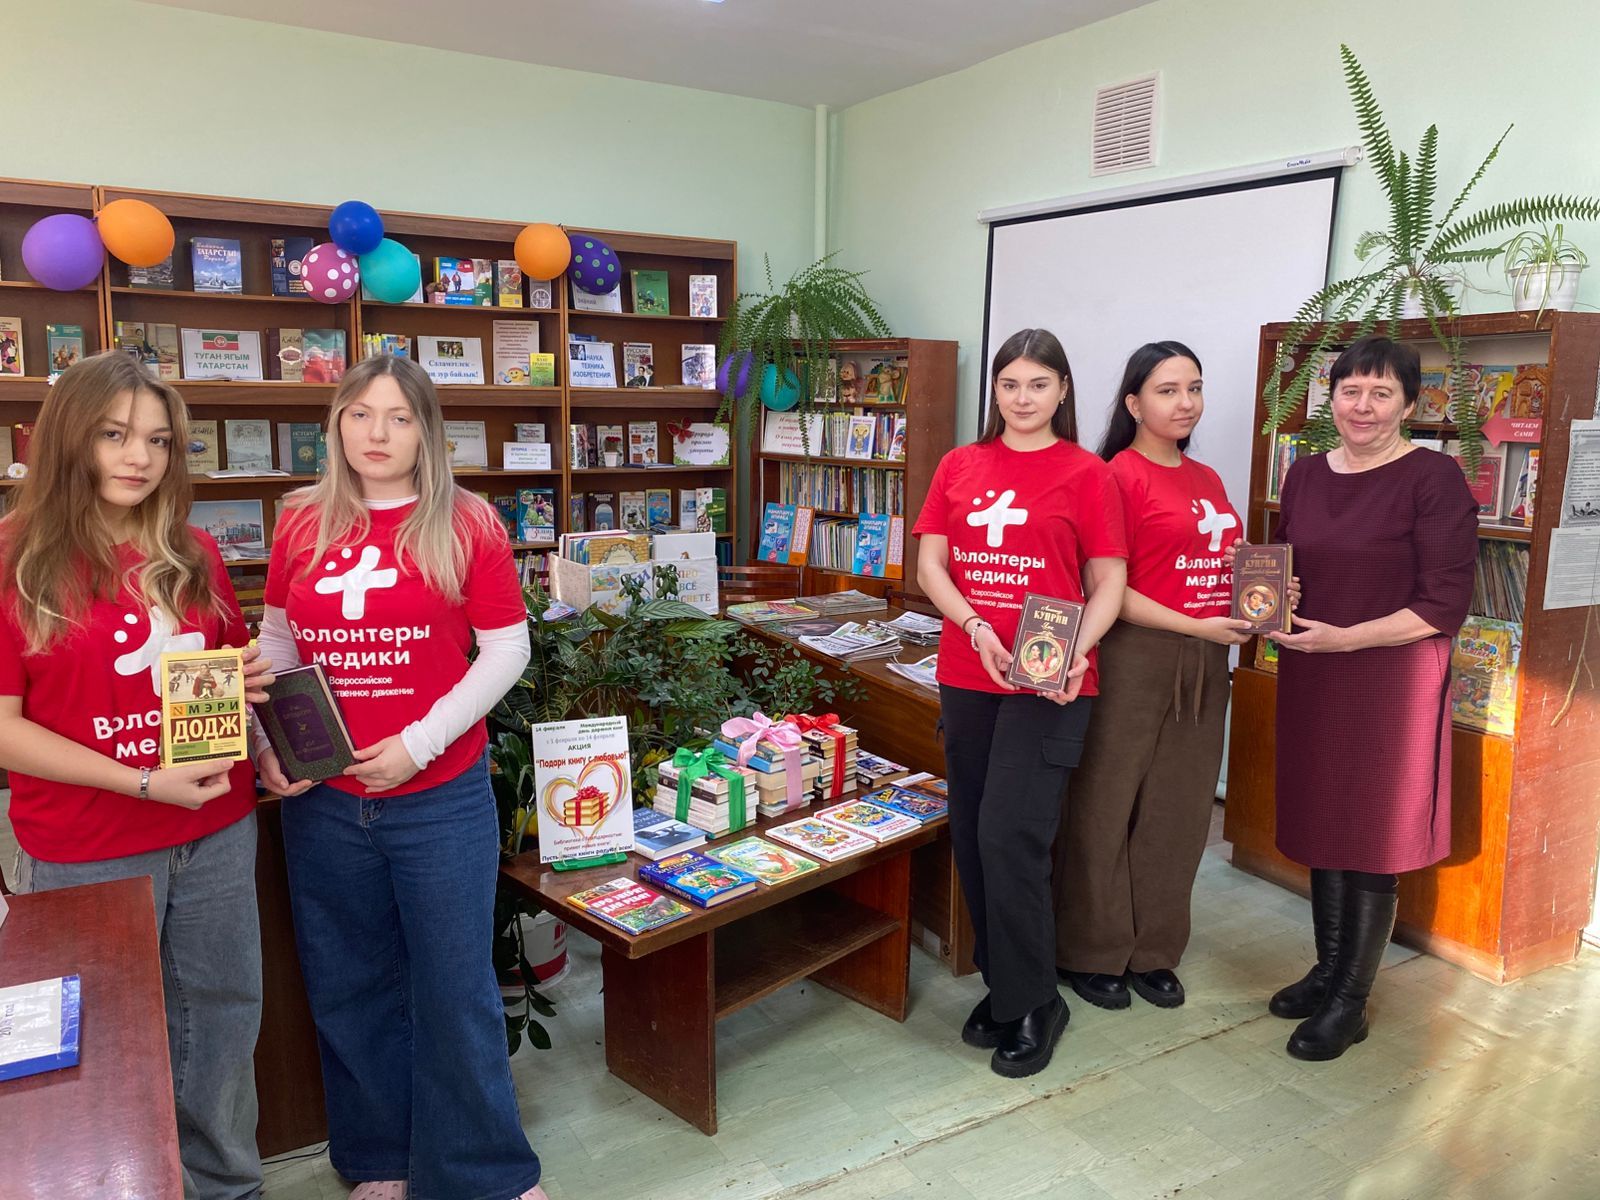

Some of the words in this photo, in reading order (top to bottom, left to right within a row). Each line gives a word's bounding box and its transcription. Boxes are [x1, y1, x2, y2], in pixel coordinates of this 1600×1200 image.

[197, 362, 248, 370] ТАТАРСТАН
[953, 546, 1045, 572] Волонтеры
[1175, 554, 1232, 570] Волон
[1034, 610, 1068, 625] КУПРИН
[290, 620, 430, 648] Волонтеры
[313, 650, 410, 670] медики
[329, 676, 392, 686] Всероссийское
[334, 689, 369, 698] твенное
[372, 688, 414, 698] движение
[188, 701, 239, 714] МЭРИ
[172, 715, 240, 744] ДОДЖ
[568, 756, 586, 765] книгу
